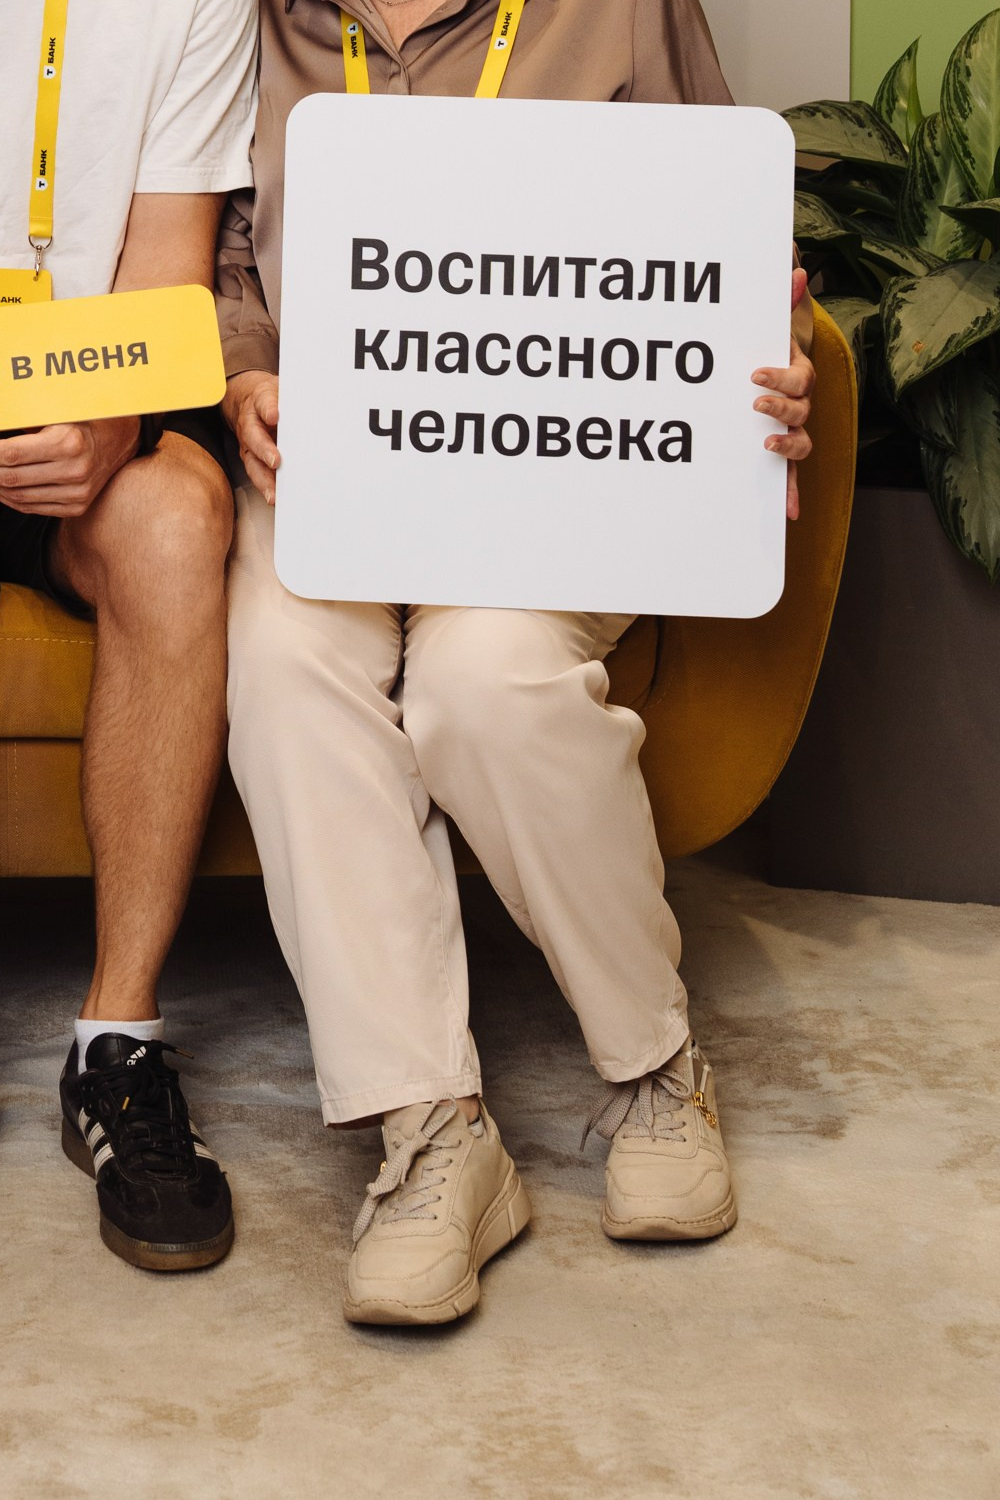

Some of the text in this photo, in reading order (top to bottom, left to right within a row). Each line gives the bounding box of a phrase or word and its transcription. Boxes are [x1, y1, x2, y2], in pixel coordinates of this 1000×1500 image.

[500, 11, 513, 37] БАНК
[47, 36, 56, 64] БАНК
[350, 35, 359, 59] БАНК
[39, 149, 48, 176] БАНК
[350, 237, 721, 303] Воспитали
[10, 353, 34, 381] в
[45, 340, 150, 377] меня
[353, 328, 714, 384] классного
[368, 408, 693, 463] человека
